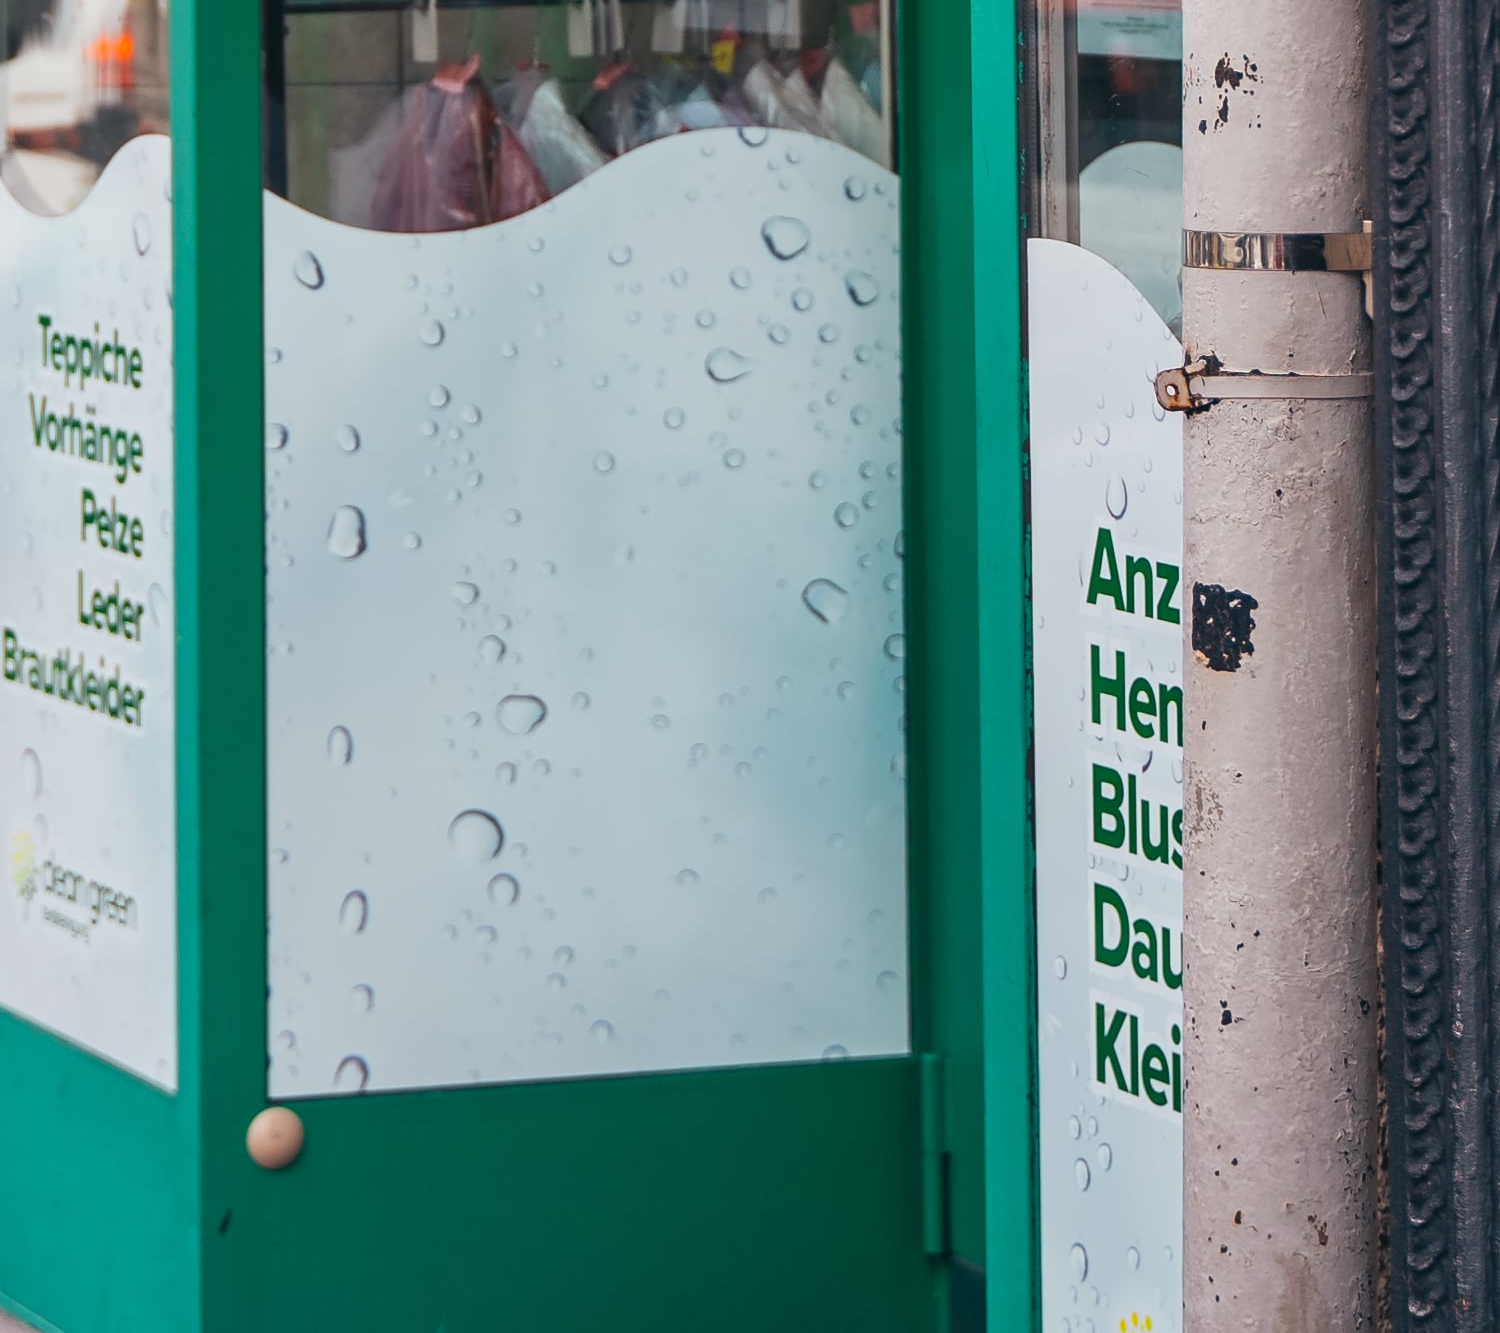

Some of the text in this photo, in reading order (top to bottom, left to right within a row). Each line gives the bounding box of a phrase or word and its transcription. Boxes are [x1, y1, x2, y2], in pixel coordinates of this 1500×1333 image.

[37, 313, 144, 391] Teppiche
[29, 393, 144, 485] Vorhänge
[80, 487, 144, 559] Pelze
[78, 569, 145, 643] Leder
[1086, 527, 1181, 625] Anz
[2, 626, 145, 727] Brautkleider
[1095, 1001, 1184, 1114] Klei
